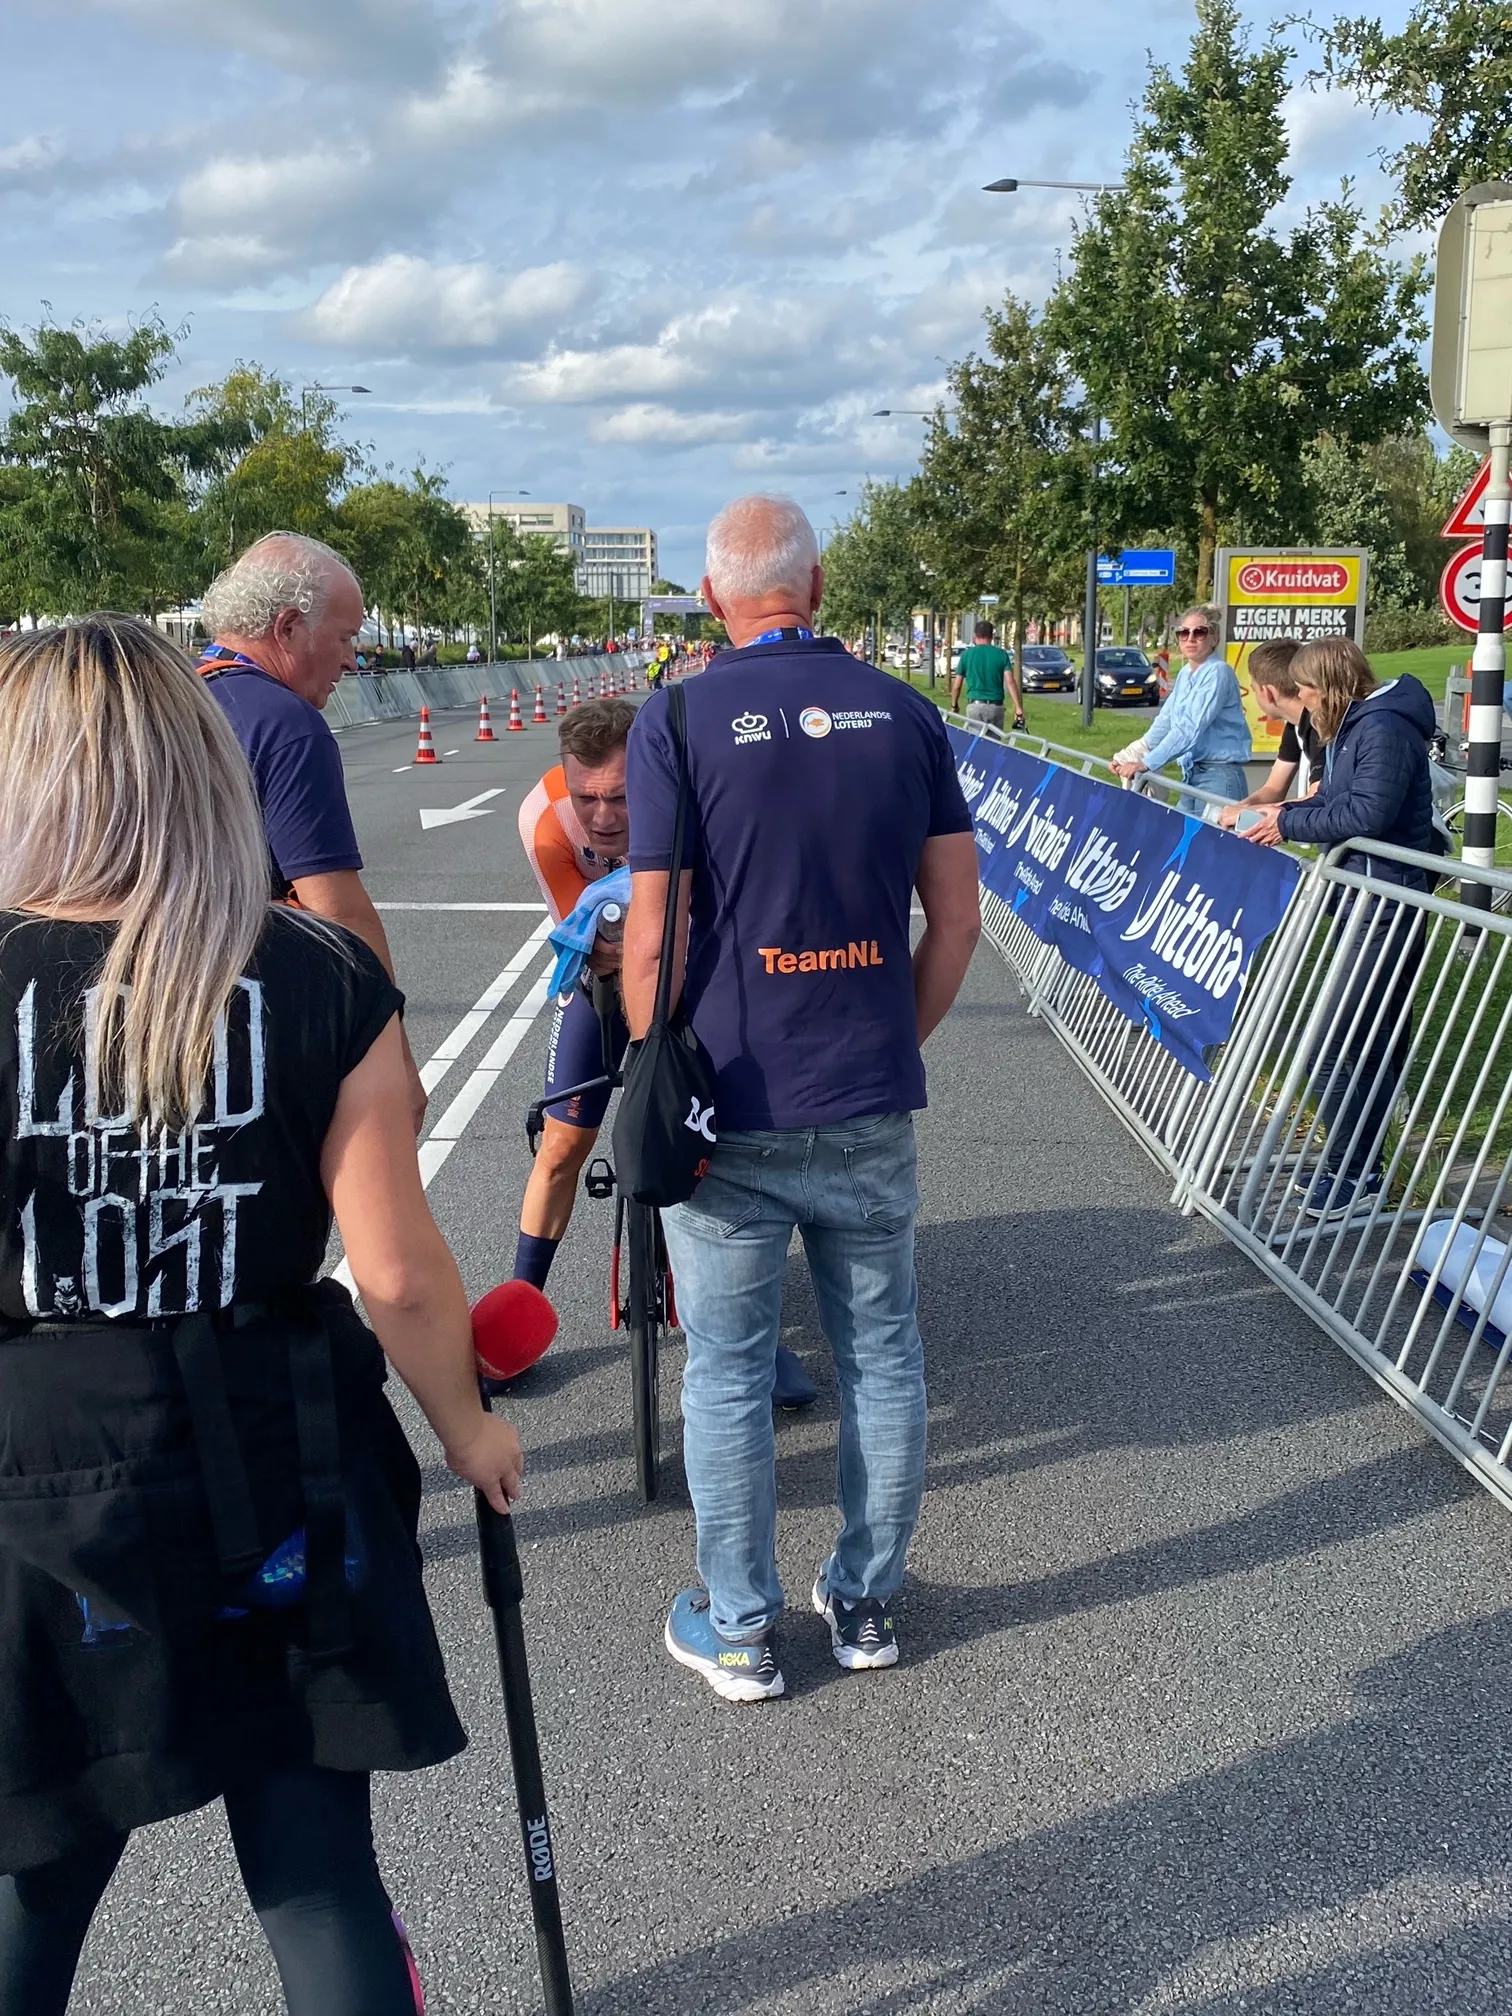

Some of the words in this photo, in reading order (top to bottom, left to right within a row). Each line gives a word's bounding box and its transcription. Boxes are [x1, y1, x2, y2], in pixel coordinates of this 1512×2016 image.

[1265, 569, 1340, 588] Kruidvat
[1236, 608, 1290, 626] EIGEN
[1294, 608, 1347, 626] MERK
[1233, 626, 1303, 640] WINNAAR
[832, 711, 892, 720] NEDERLANDSE
[834, 719, 872, 730] LOTERIJ
[758, 939, 883, 974] TeamNL
[1123, 963, 1147, 984] The
[1150, 990, 1201, 1019] Ahead
[547, 1010, 564, 1084] NEDERLANDSE
[14, 976, 266, 1139] LOD
[19, 1181, 266, 1319] LOST
[719, 1652, 751, 1666] HOKA
